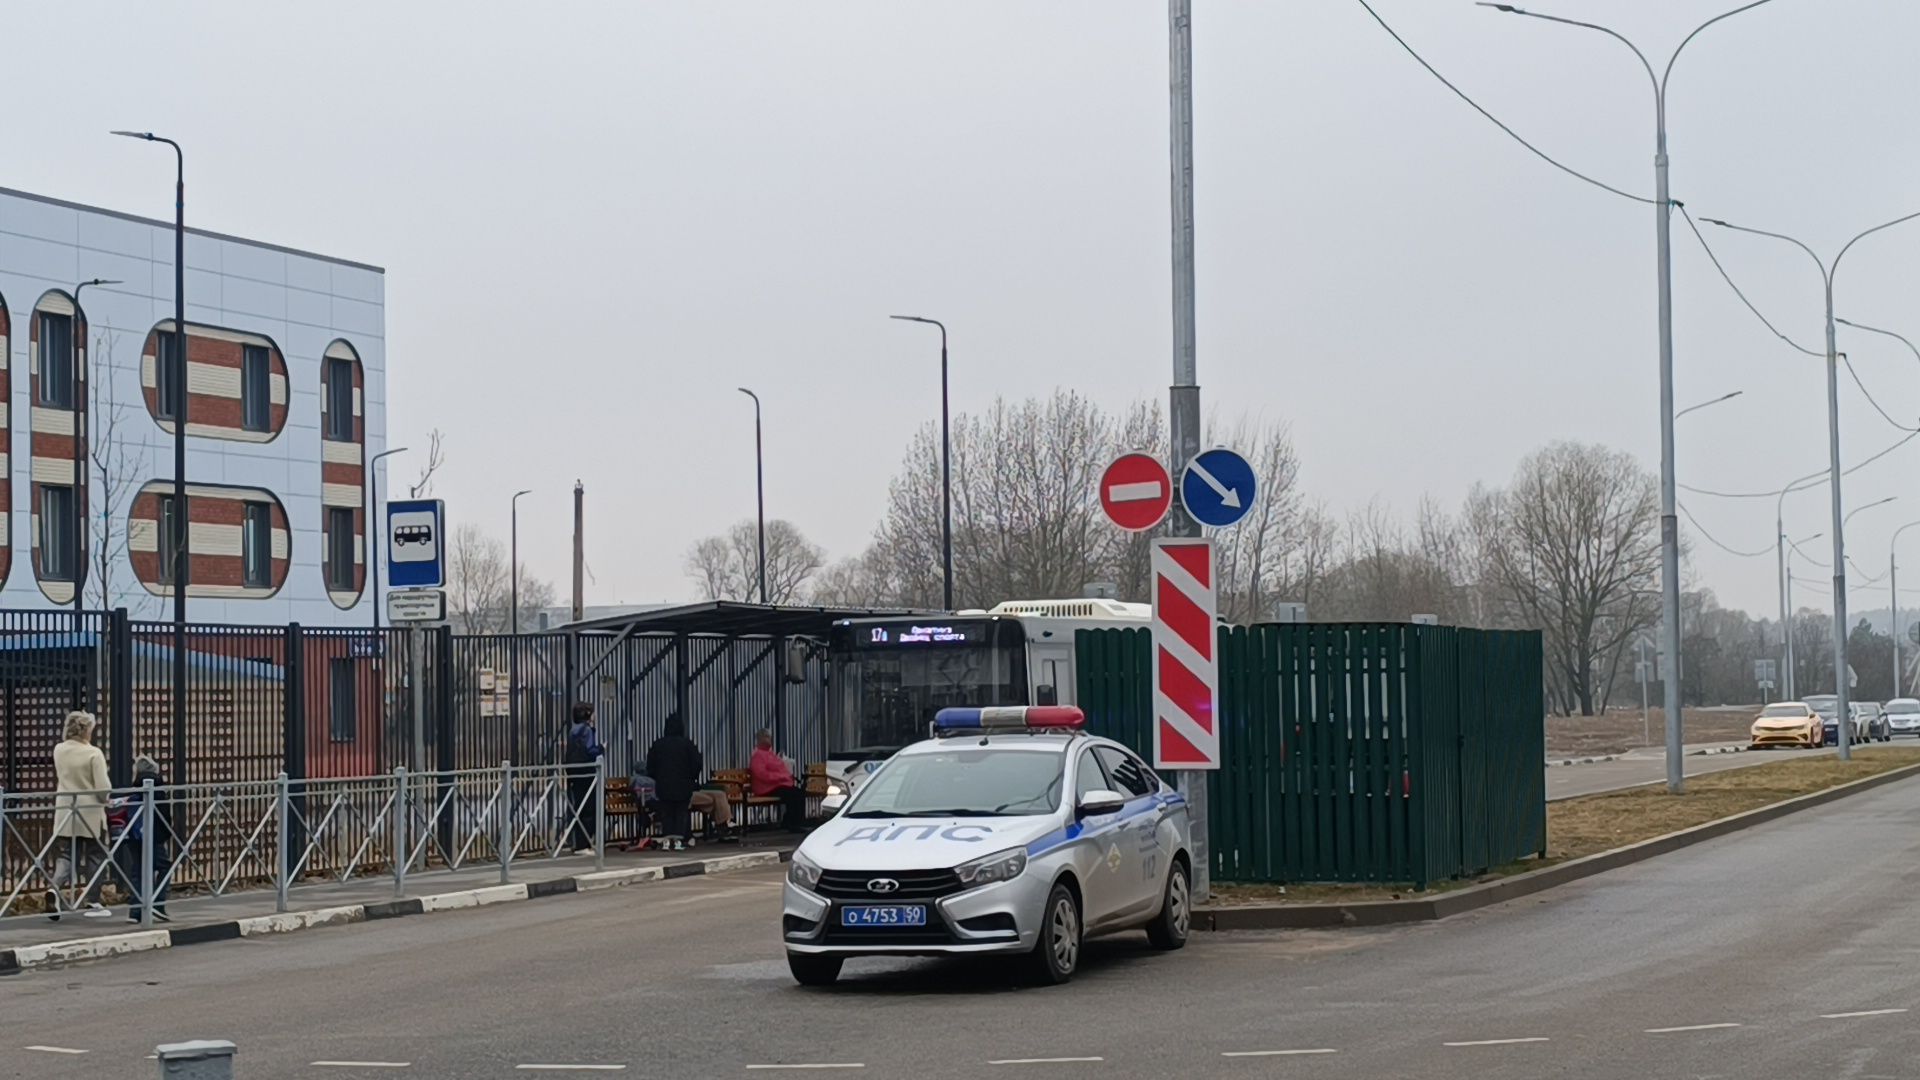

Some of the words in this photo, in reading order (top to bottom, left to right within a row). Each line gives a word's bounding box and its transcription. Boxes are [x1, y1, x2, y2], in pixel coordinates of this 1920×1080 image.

[834, 825, 993, 847] ДПС
[1142, 854, 1156, 880] 112
[862, 908, 898, 923] 4753
[906, 906, 920, 920] 50
